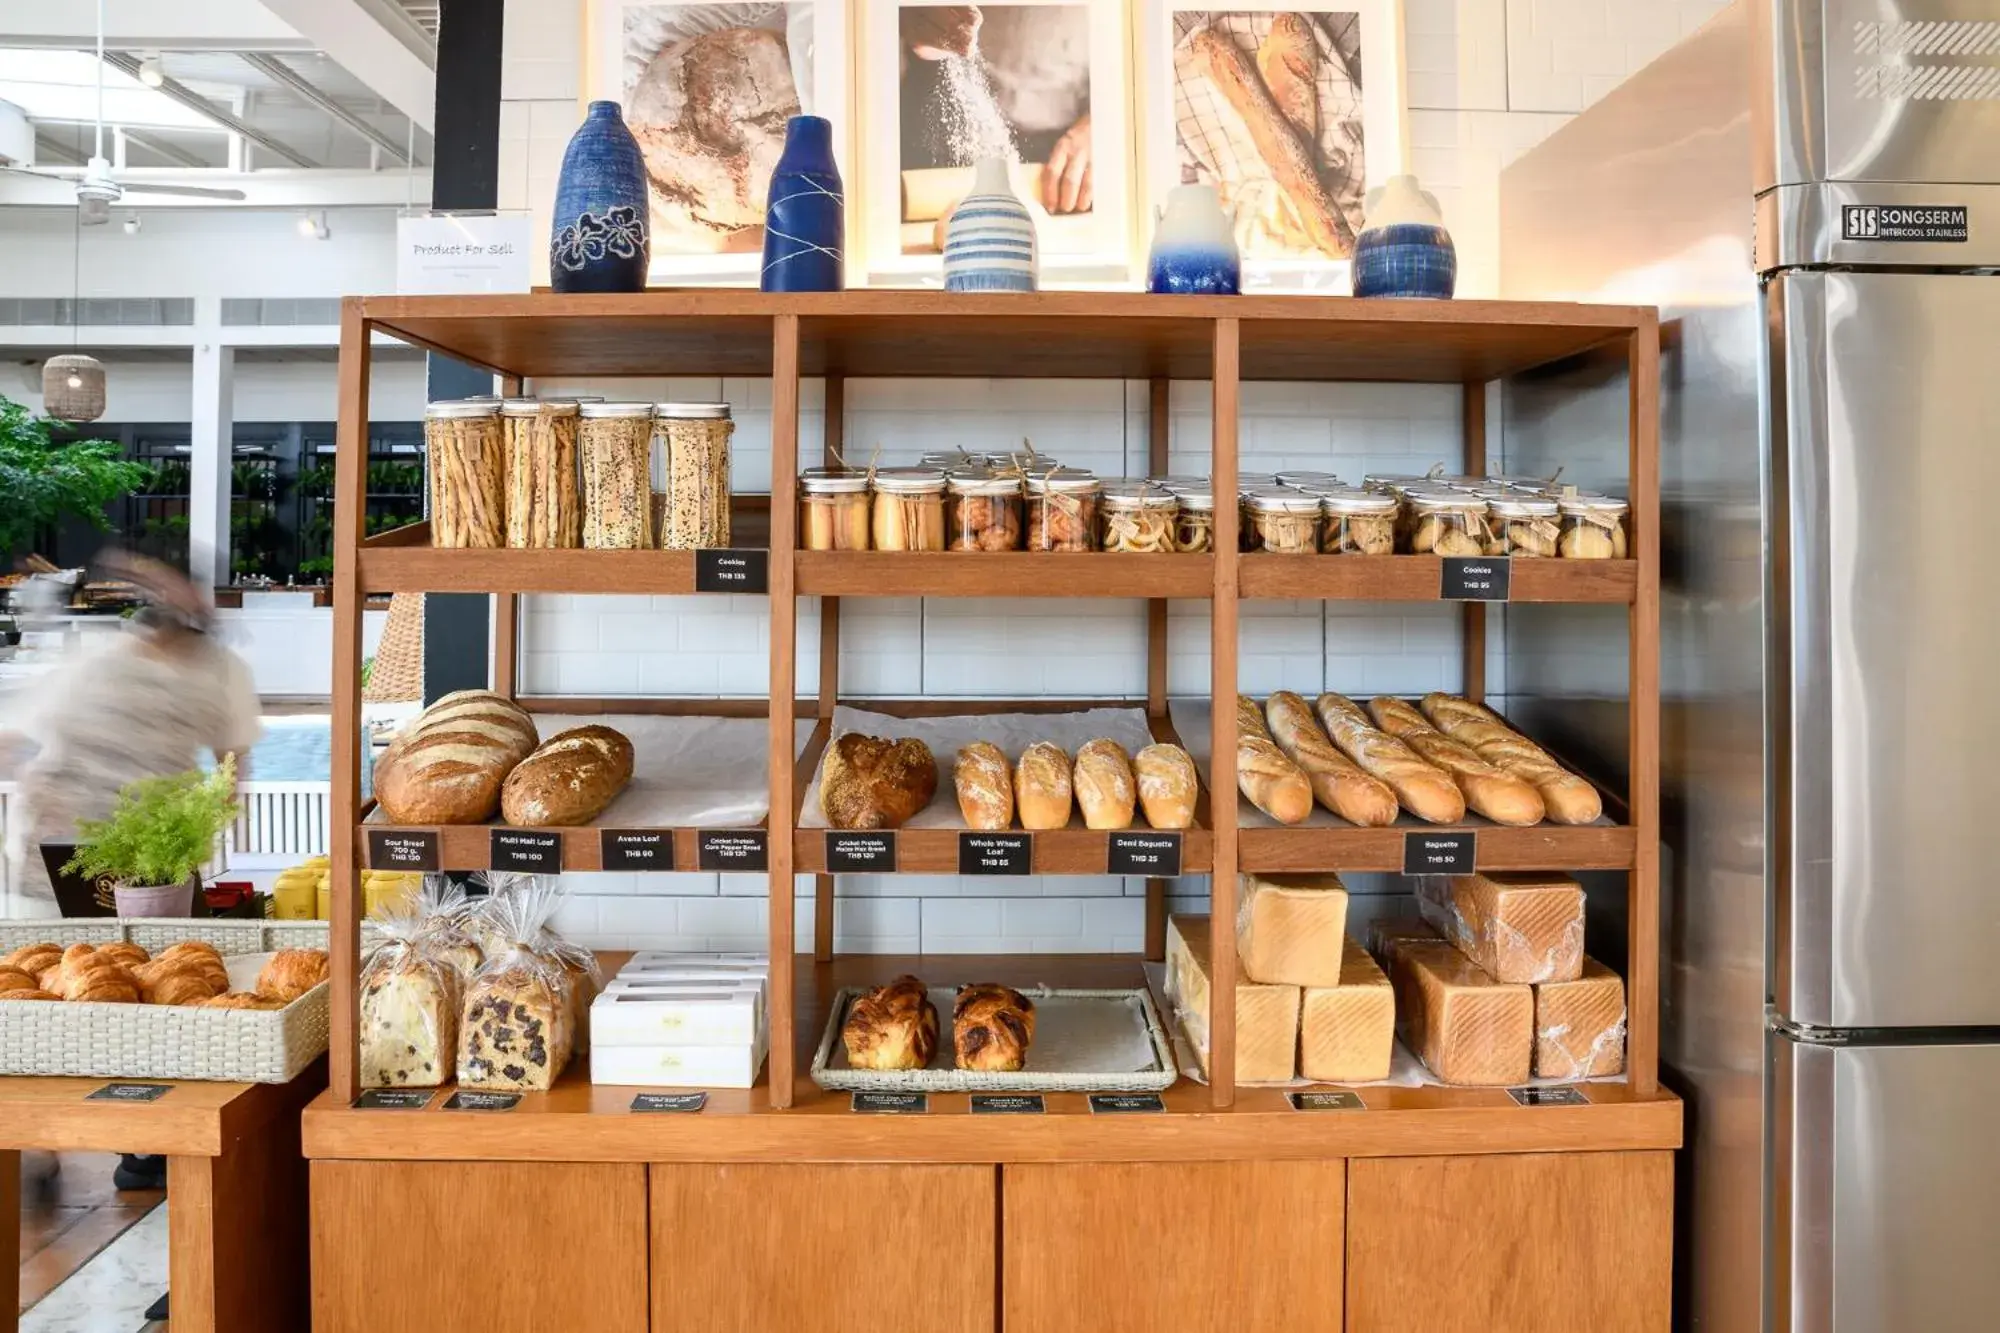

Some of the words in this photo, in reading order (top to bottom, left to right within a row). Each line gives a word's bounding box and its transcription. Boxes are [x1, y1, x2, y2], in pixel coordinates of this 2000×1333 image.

[1880, 210, 1965, 224] SONGSERM
[1849, 208, 1876, 236] SIS
[1880, 227, 1924, 237] INTERCOOL
[1926, 228, 1966, 237] STAINLESS
[413, 244, 461, 255] Product
[465, 244, 484, 254] For
[487, 241, 515, 255] Sell
[1463, 566, 1492, 574] Cookies
[717, 572, 733, 580] THB
[1463, 581, 1479, 589] THB
[384, 839, 402, 847] Sour
[403, 839, 425, 847] Bread
[500, 836, 518, 845] Multi
[537, 839, 554, 847] Loaf
[970, 839, 995, 847] Whole
[996, 839, 1021, 848] Wheat
[1138, 840, 1173, 848] Baguette
[1424, 841, 1459, 849] Baguette
[511, 852, 528, 860] THB
[529, 852, 543, 861] 100
[625, 849, 641, 857] THB
